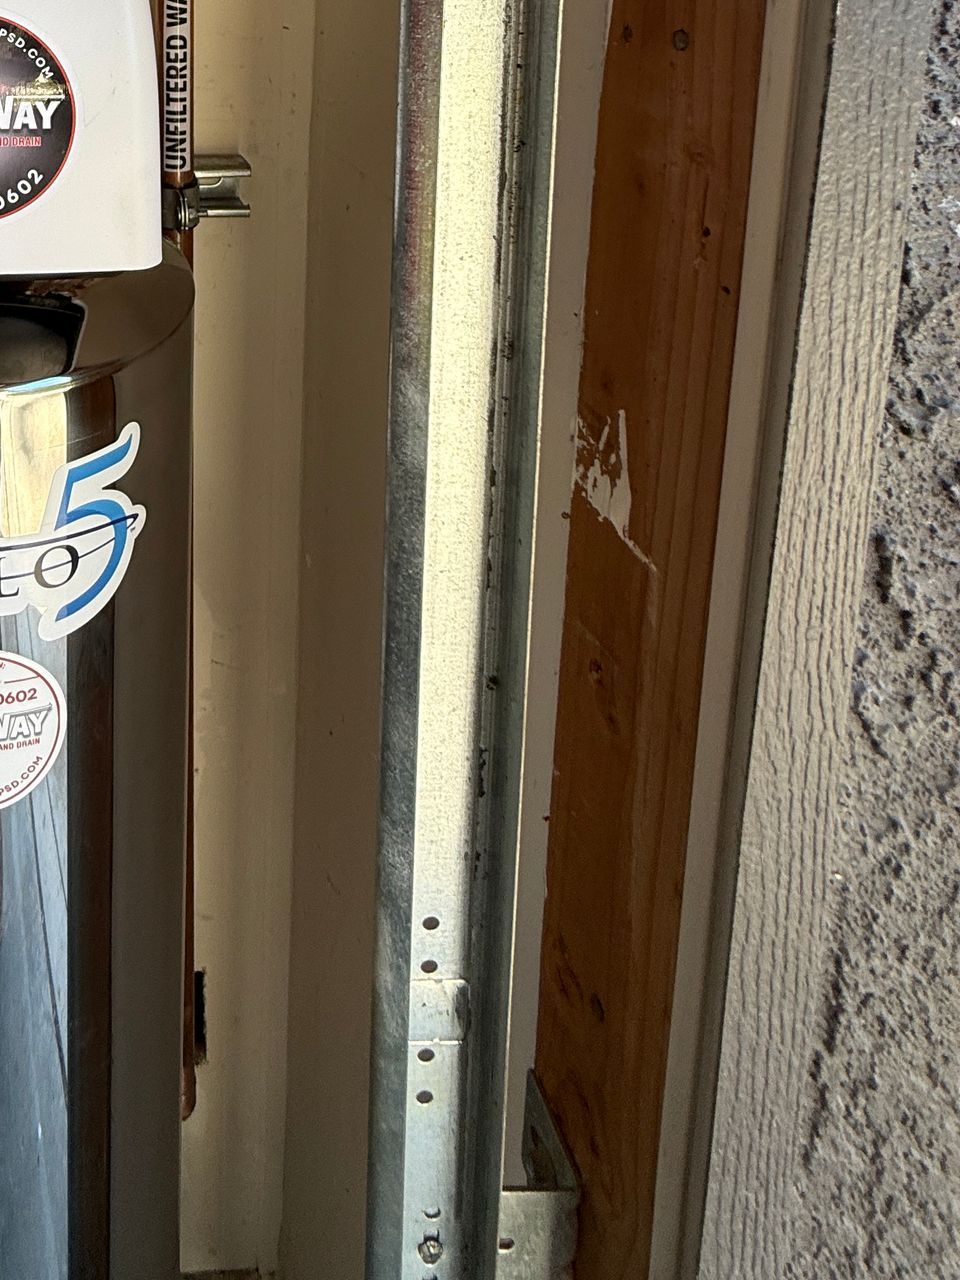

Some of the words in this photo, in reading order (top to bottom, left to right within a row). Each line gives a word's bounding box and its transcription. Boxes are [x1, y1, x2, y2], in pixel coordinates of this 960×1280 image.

[165, 35, 189, 170] UNFILTERED
[12, 136, 42, 146] DRAIN
[53, 433, 134, 622] 5
[16, 738, 41, 749] DRAIN
